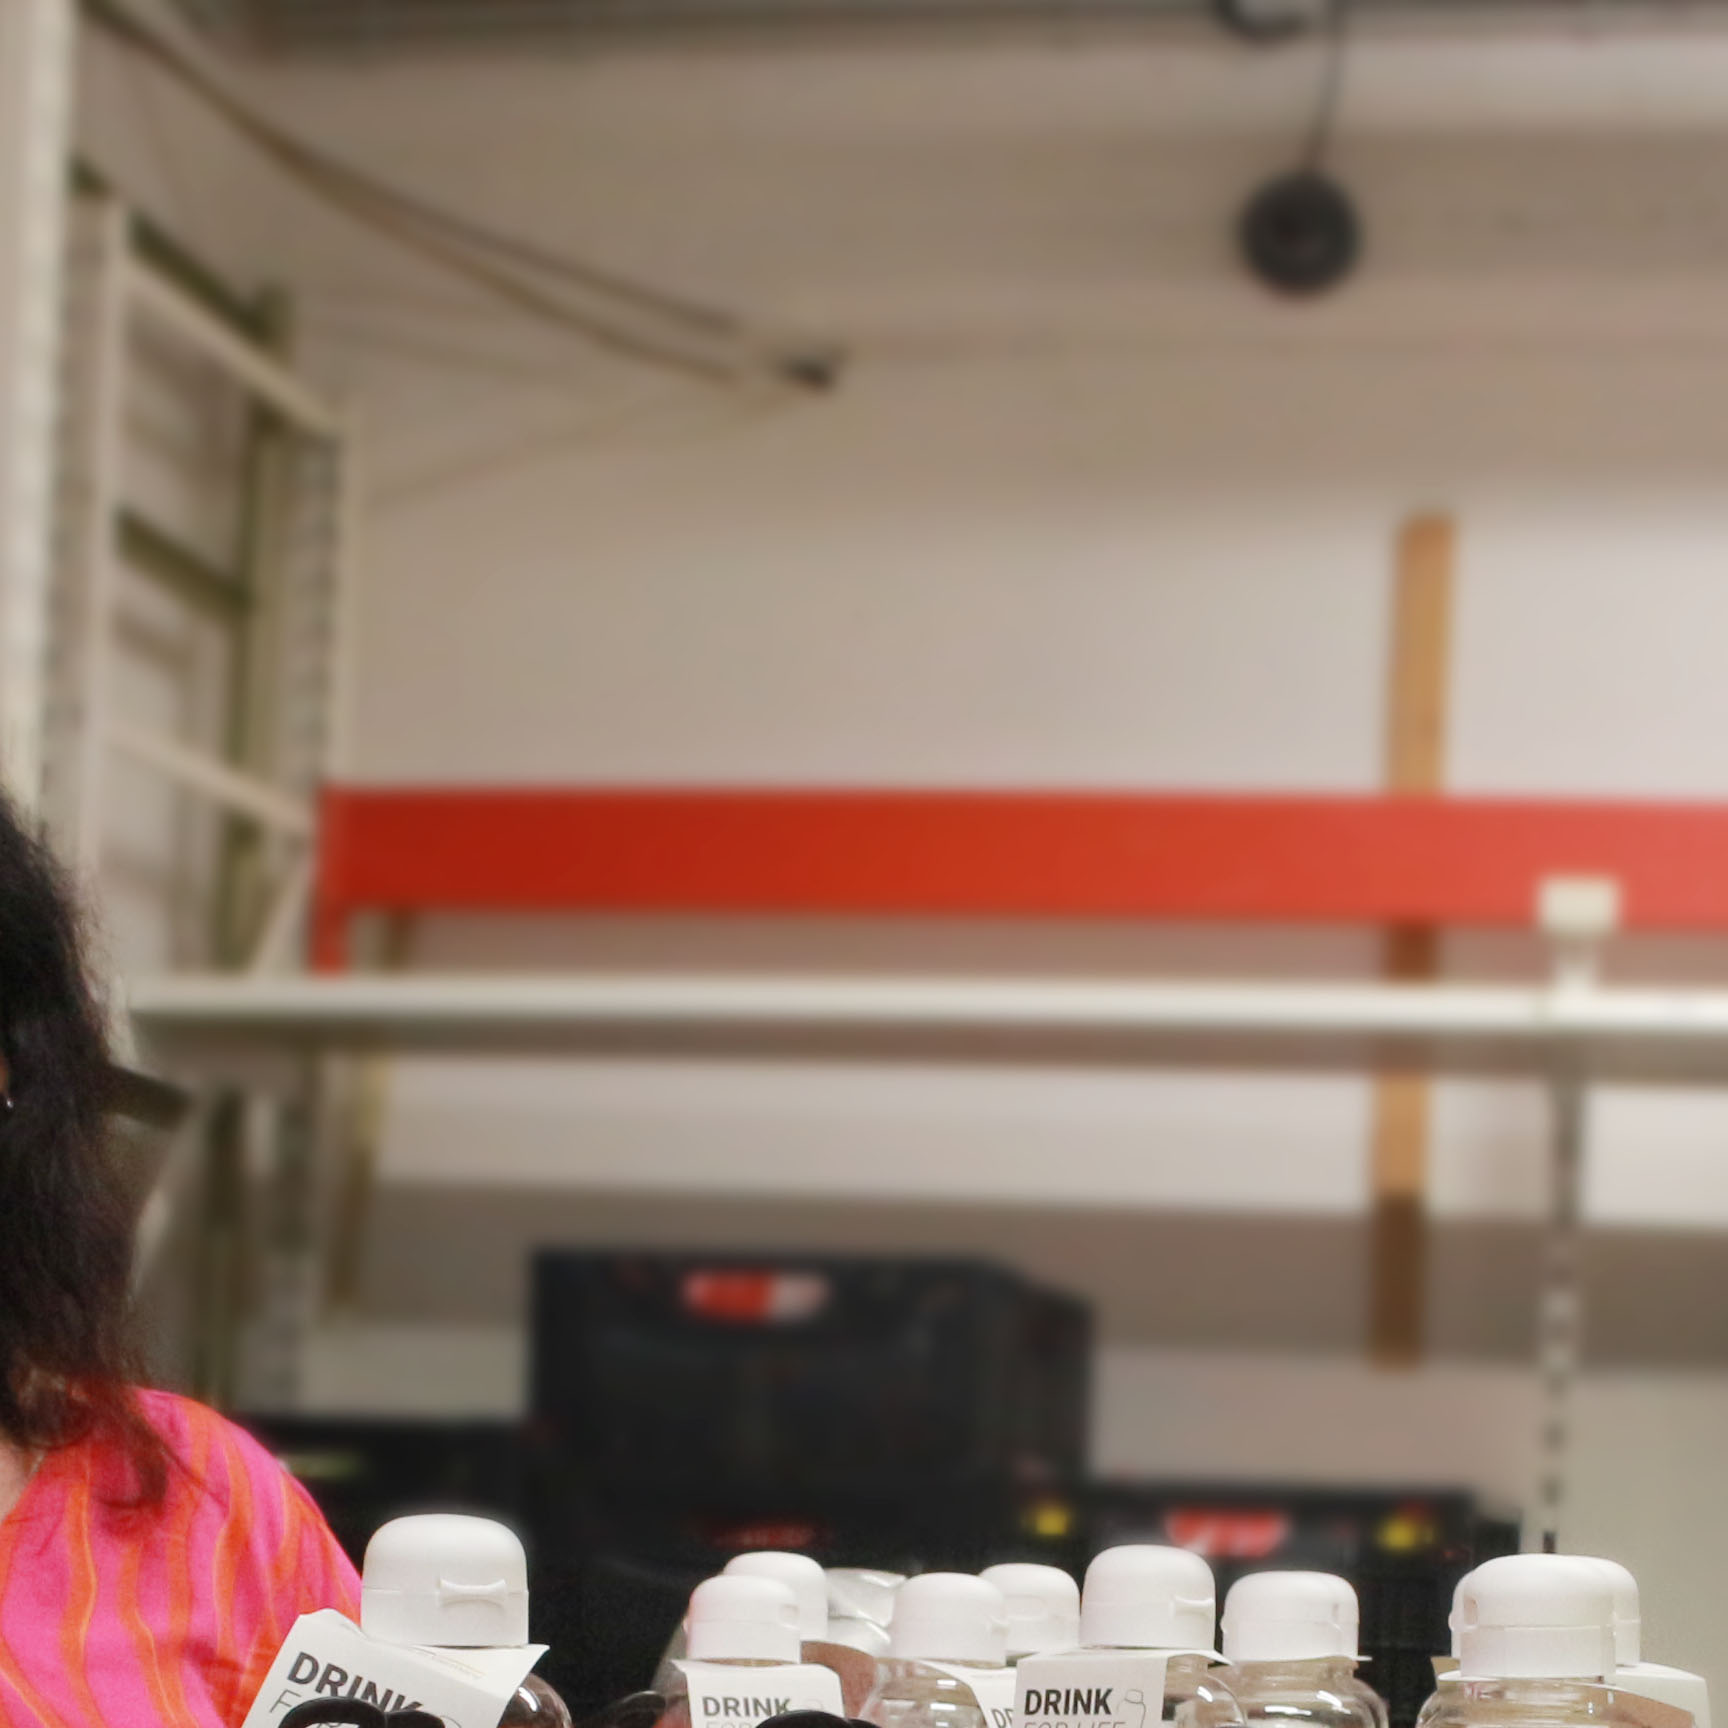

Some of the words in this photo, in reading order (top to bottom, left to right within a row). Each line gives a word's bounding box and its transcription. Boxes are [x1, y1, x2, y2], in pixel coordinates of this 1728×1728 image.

[287, 1651, 424, 1713] DRINK
[702, 1696, 792, 1718] DRINK
[1025, 1688, 1113, 1716] DRINK
